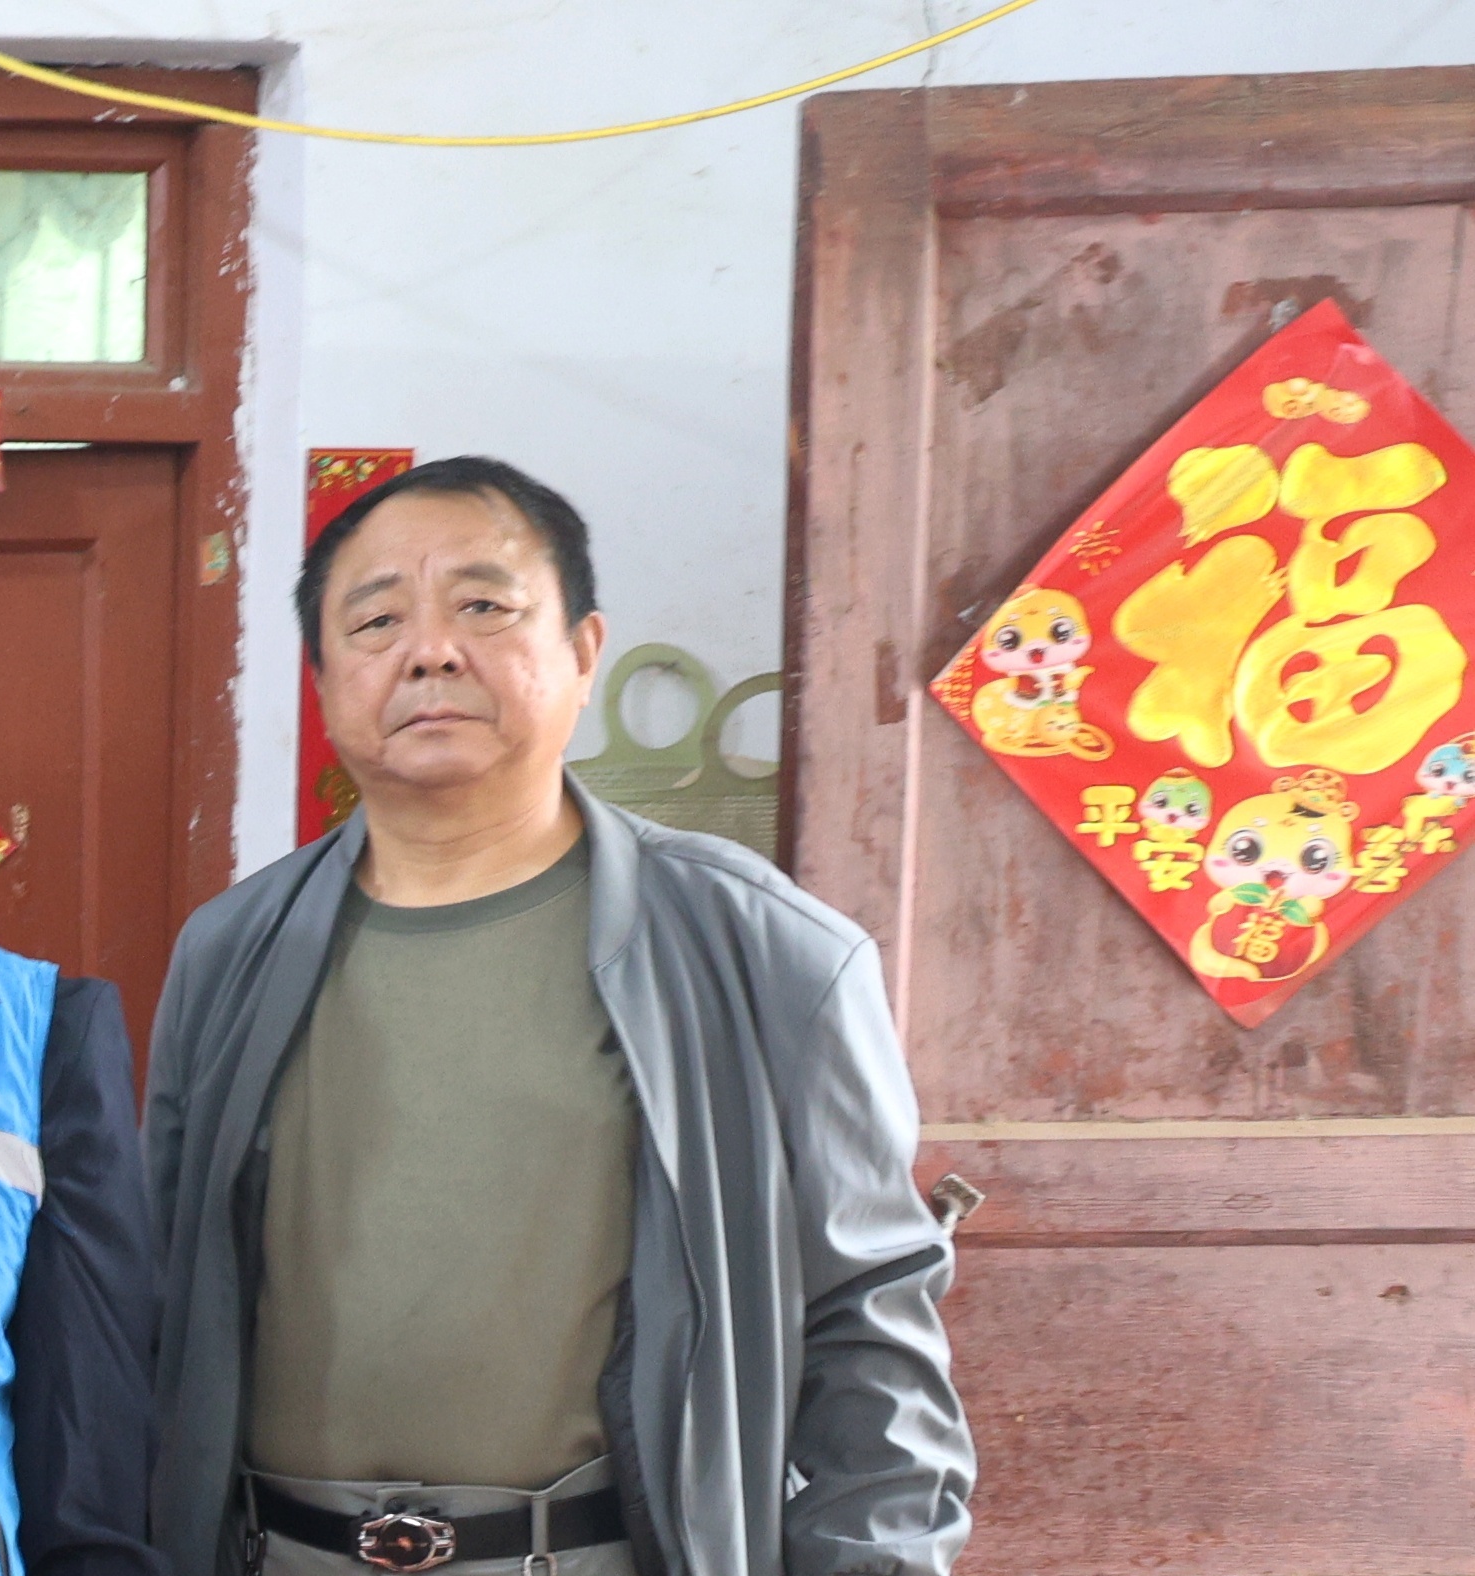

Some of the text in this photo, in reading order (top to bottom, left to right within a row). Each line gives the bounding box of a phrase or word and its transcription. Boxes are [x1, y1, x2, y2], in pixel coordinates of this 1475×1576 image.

[1113, 442, 1467, 774] 福
[1075, 784, 1206, 893] 平安
[1232, 912, 1285, 963] 福
